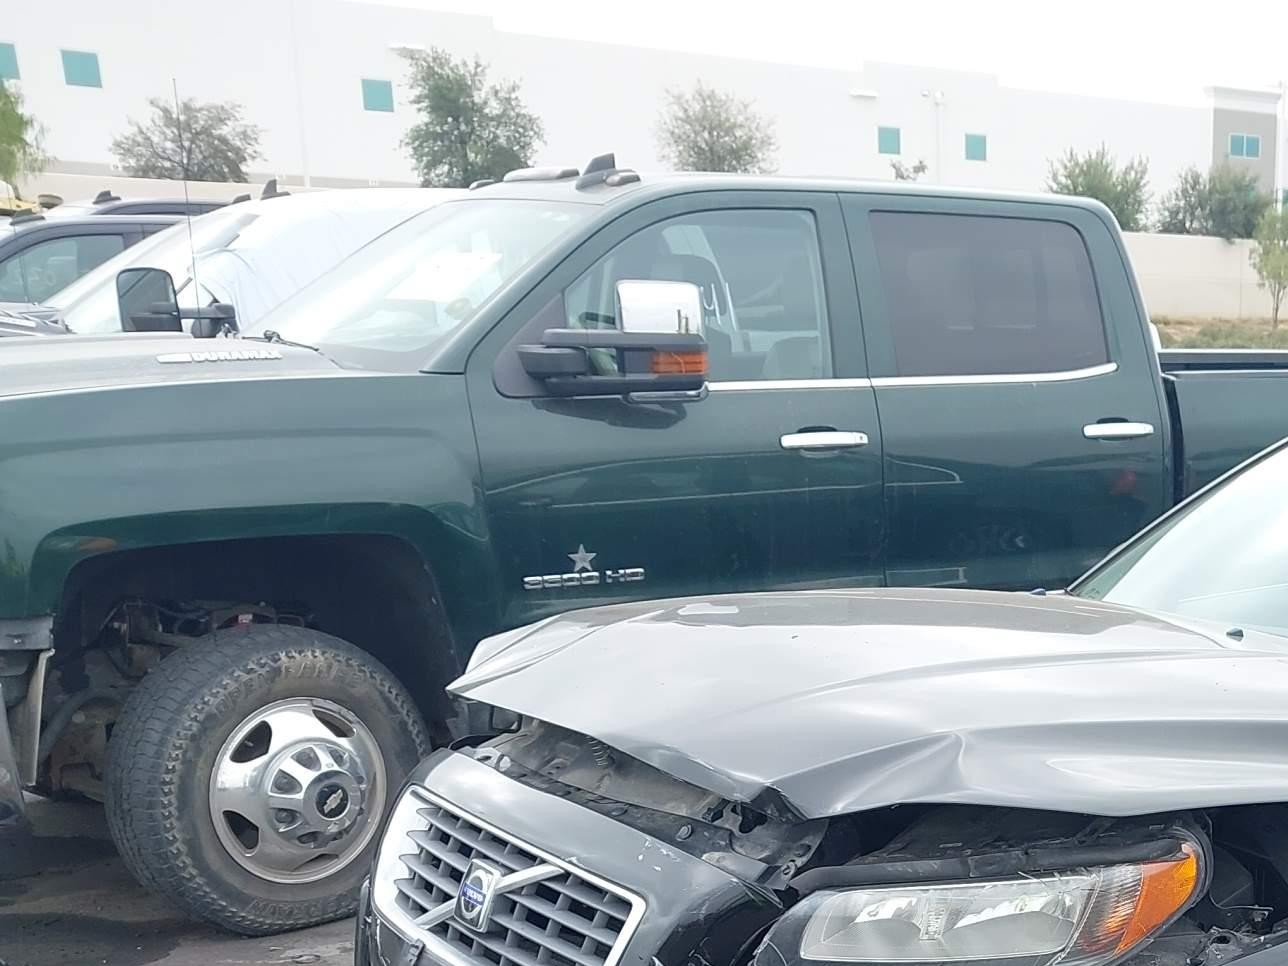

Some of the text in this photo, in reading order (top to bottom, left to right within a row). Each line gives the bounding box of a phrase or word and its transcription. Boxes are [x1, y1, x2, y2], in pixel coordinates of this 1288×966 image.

[191, 350, 283, 362] DURAMAX
[522, 567, 645, 590] 3500 HD
